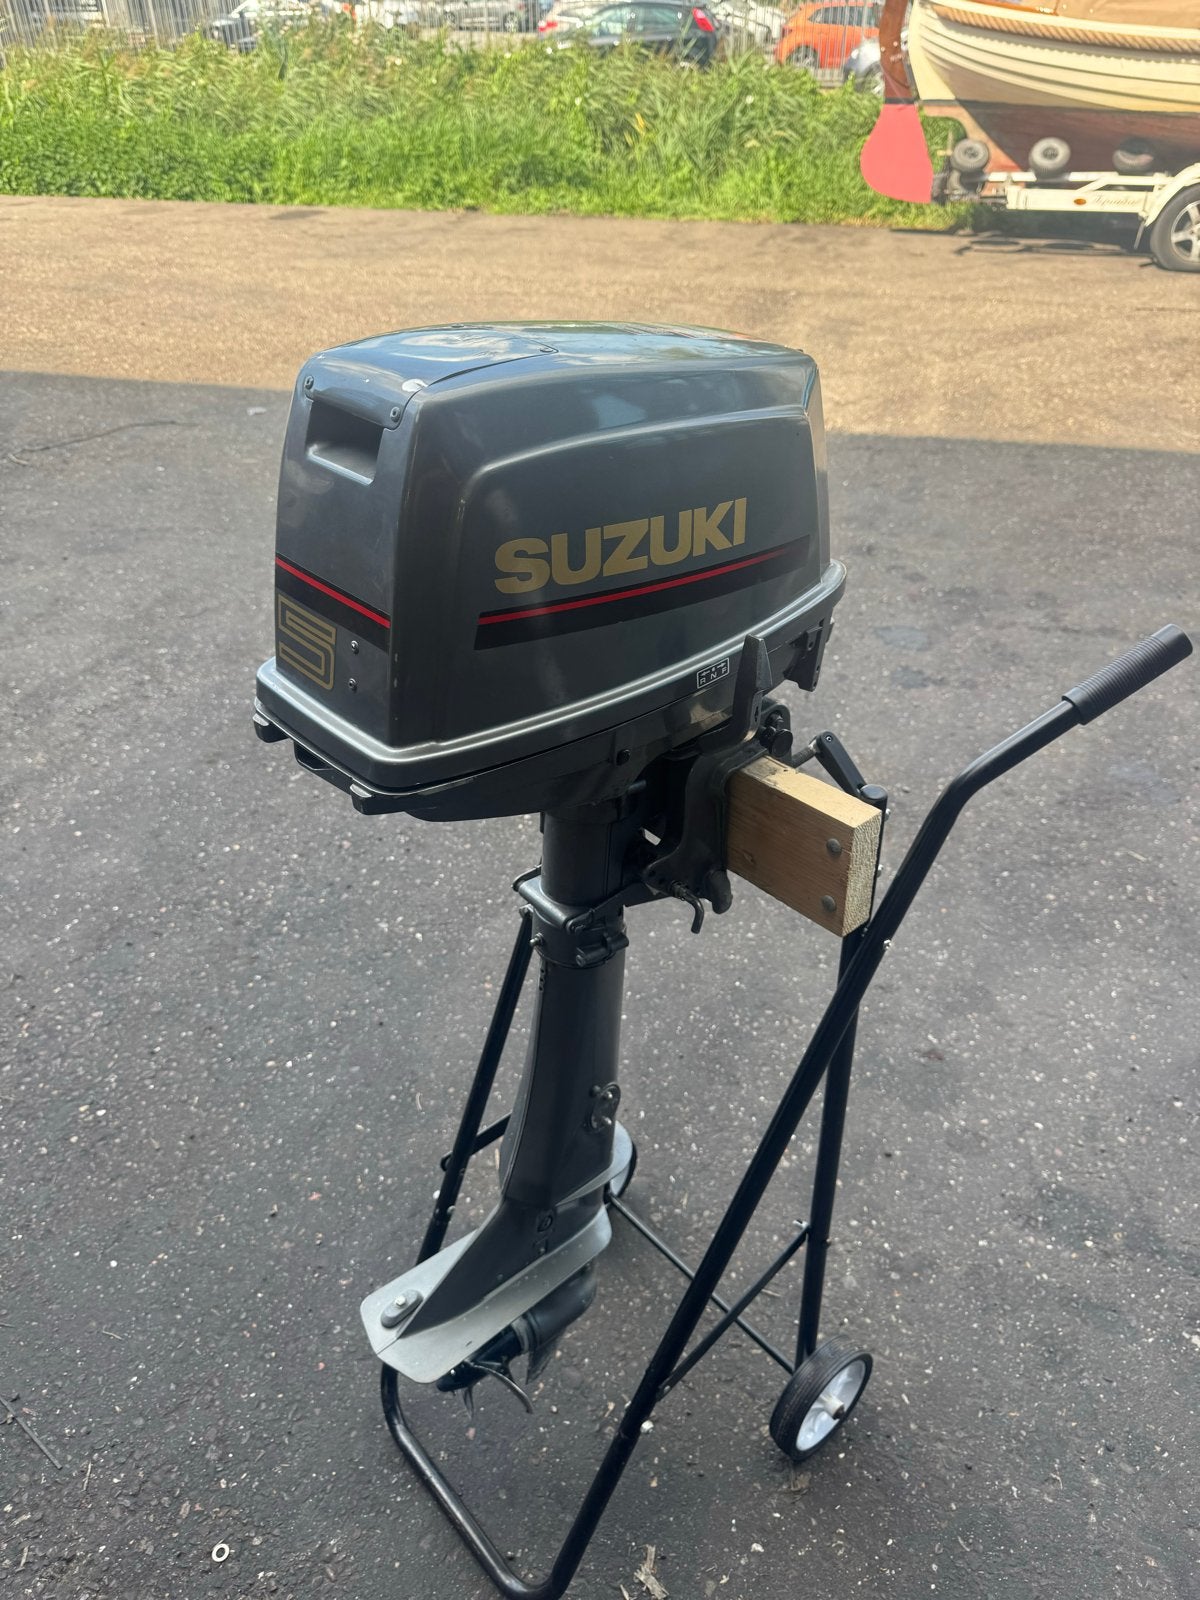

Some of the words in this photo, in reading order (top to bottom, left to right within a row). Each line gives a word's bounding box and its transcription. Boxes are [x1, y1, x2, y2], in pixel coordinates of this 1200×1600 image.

[494, 497, 747, 594] SUZUKI
[710, 672, 717, 680] N
[722, 666, 727, 674] F
